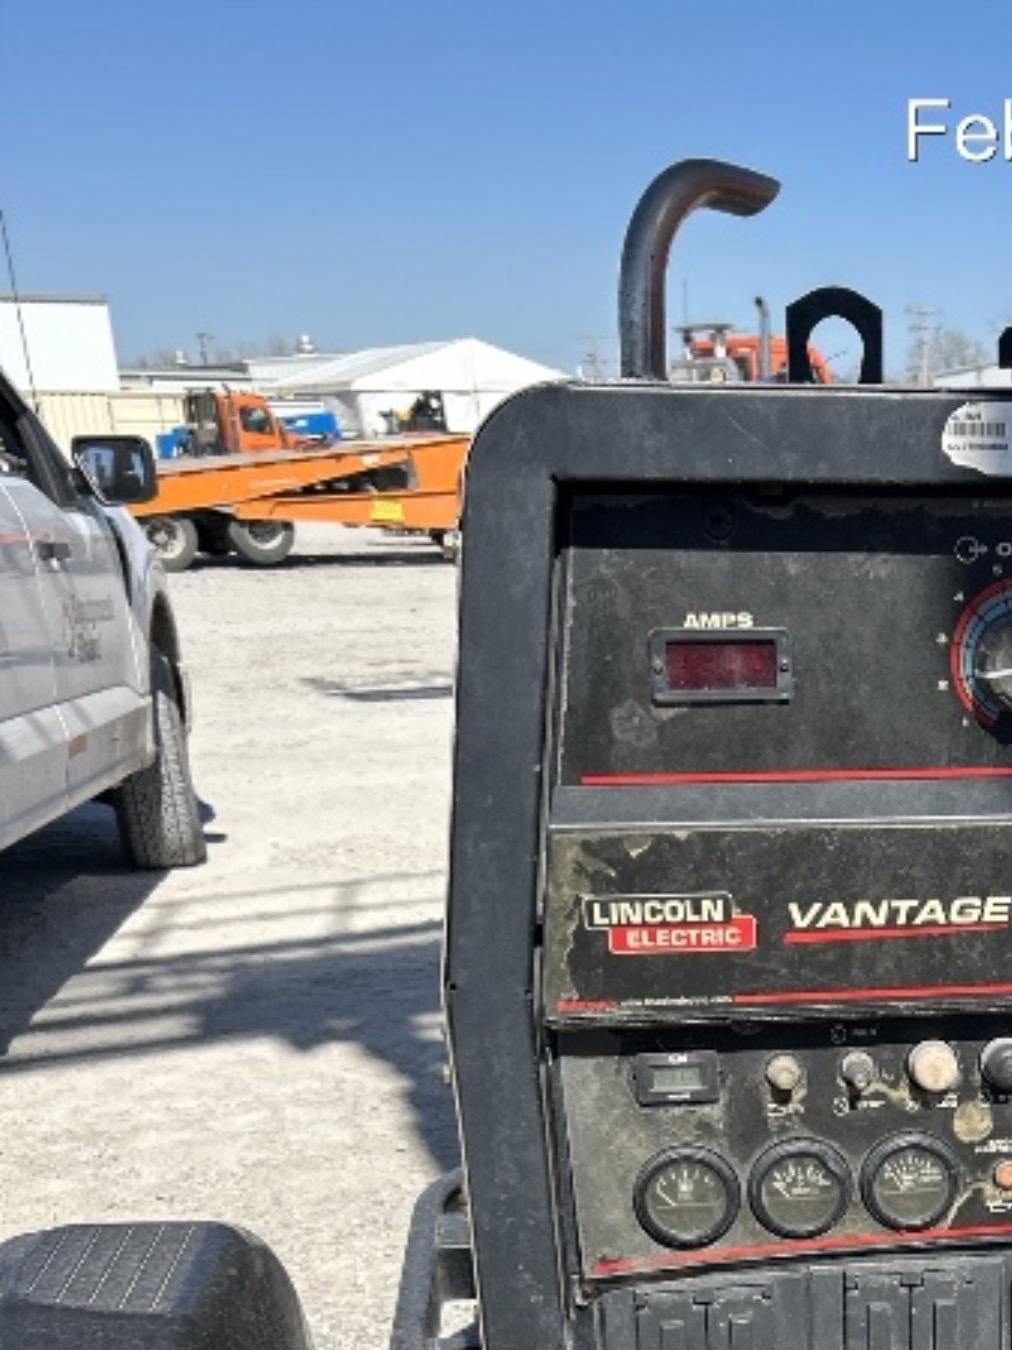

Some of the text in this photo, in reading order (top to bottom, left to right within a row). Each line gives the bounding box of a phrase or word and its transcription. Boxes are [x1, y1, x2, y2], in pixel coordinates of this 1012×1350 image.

[683, 611, 755, 629] AMPS
[592, 898, 725, 927] LINCOLN
[787, 896, 1011, 929] VANTAGE
[626, 926, 742, 949] ELECTRIC
